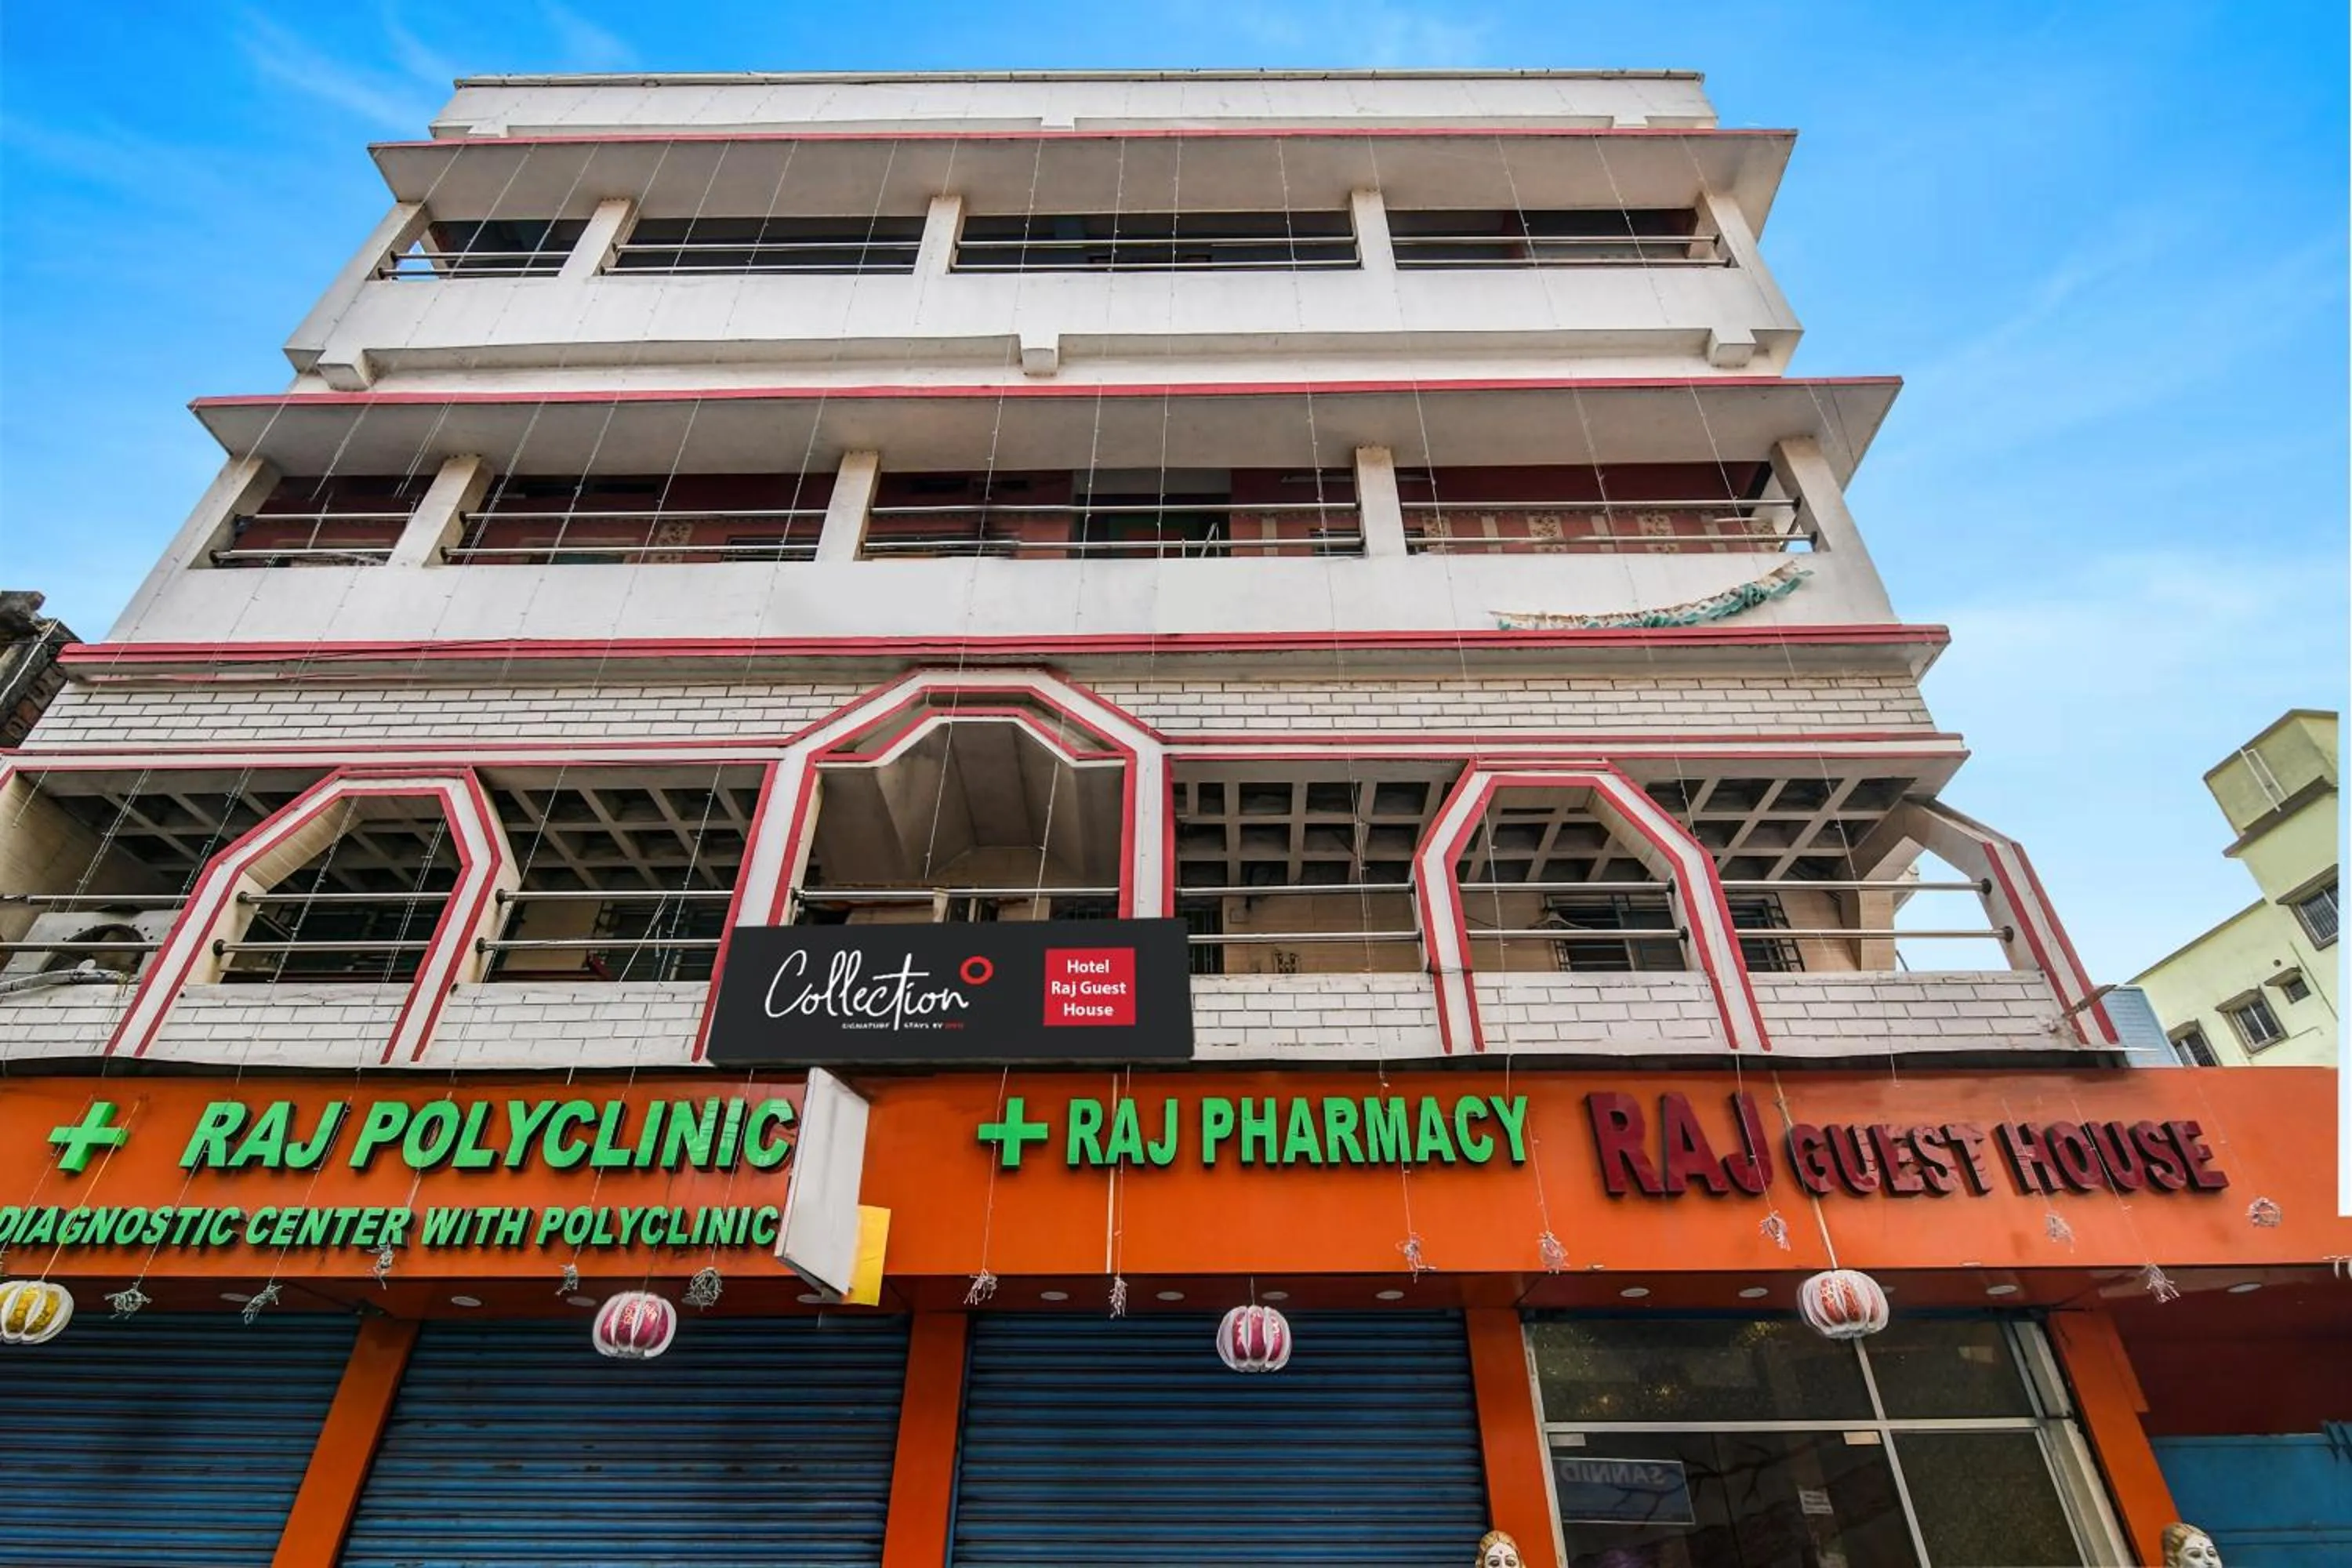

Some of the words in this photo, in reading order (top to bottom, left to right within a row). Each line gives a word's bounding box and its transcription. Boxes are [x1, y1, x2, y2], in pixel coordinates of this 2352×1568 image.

[764, 949, 970, 1031] Collection
[1051, 980, 1077, 998] Raj
[1080, 981, 1127, 995] Guest
[1067, 959, 1109, 974] Hotel
[1063, 1002, 1114, 1017] House
[180, 1101, 345, 1170] RAJ
[350, 1098, 794, 1168] POLYCLINIC
[1067, 1098, 1178, 1166] RAJ
[1203, 1095, 1528, 1164] PHARMACY
[1584, 1091, 1773, 1196] RAJ
[1788, 1123, 1992, 1196] GUEST
[1996, 1121, 2230, 1196] HOUSE
[0, 1206, 241, 1246] DIAGNOSTIC
[245, 1207, 412, 1247] CENTER
[422, 1207, 532, 1246] WITH
[536, 1206, 779, 1246] POLYCLINIC
